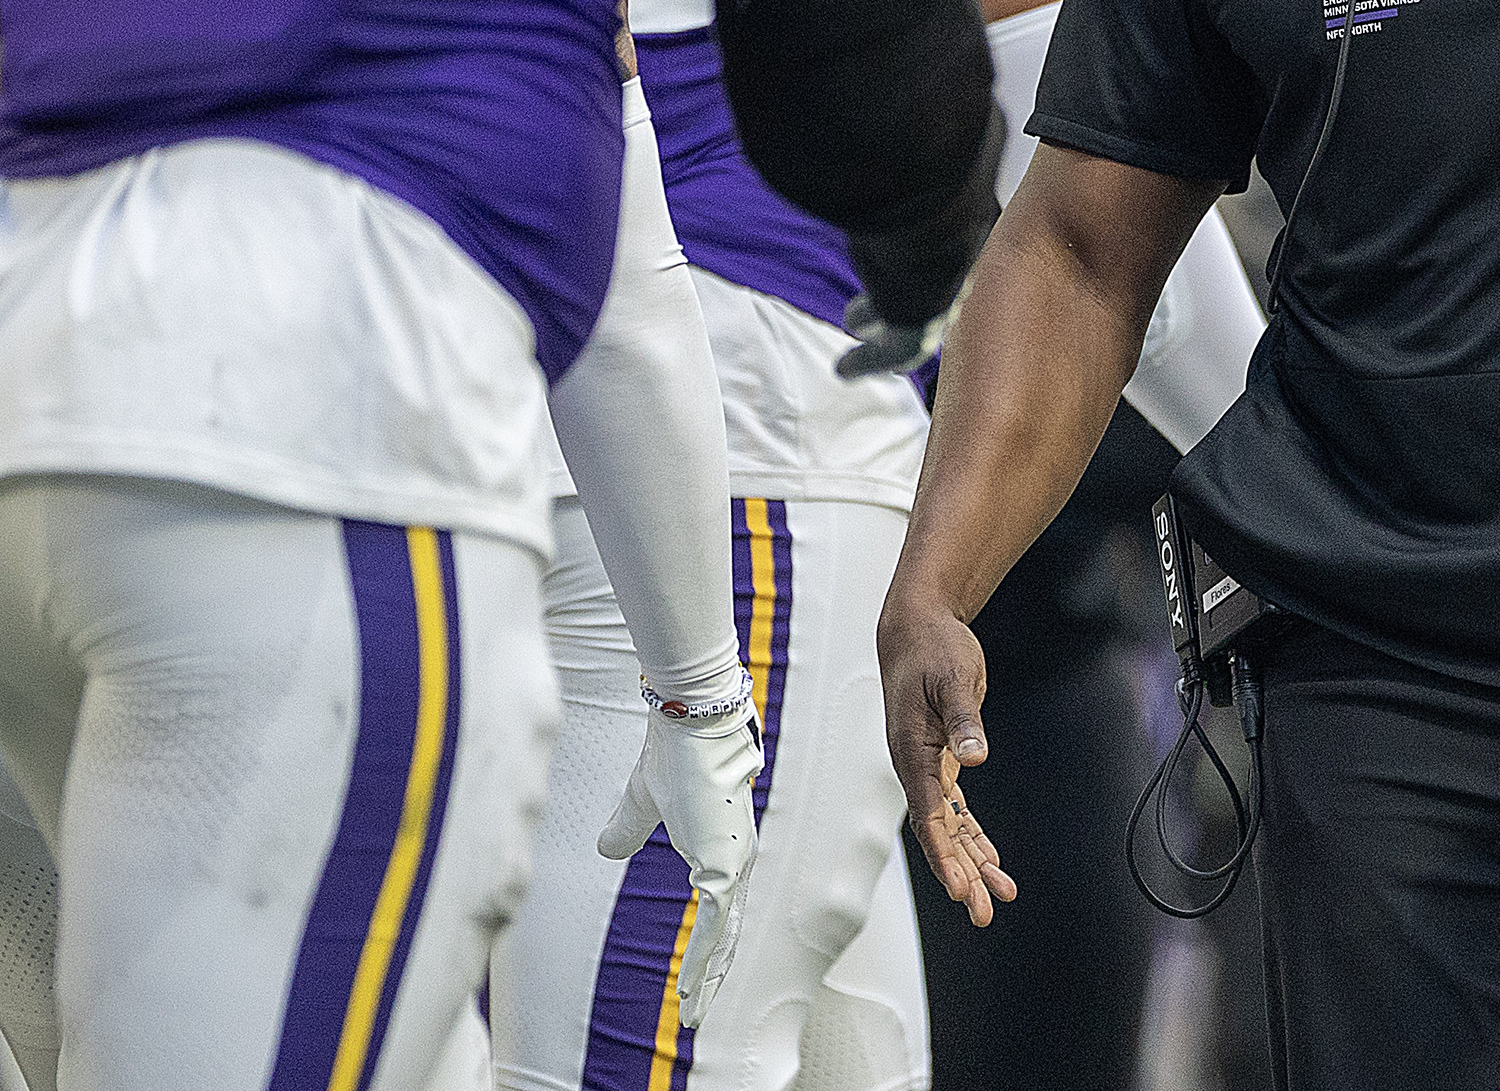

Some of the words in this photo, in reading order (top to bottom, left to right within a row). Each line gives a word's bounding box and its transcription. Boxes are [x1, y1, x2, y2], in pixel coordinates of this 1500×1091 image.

[1324, 0, 1379, 18] MINNSOTA
[1326, 28, 1345, 41] NFC
[1156, 511, 1184, 629] SONY
[1210, 582, 1231, 603] Flores
